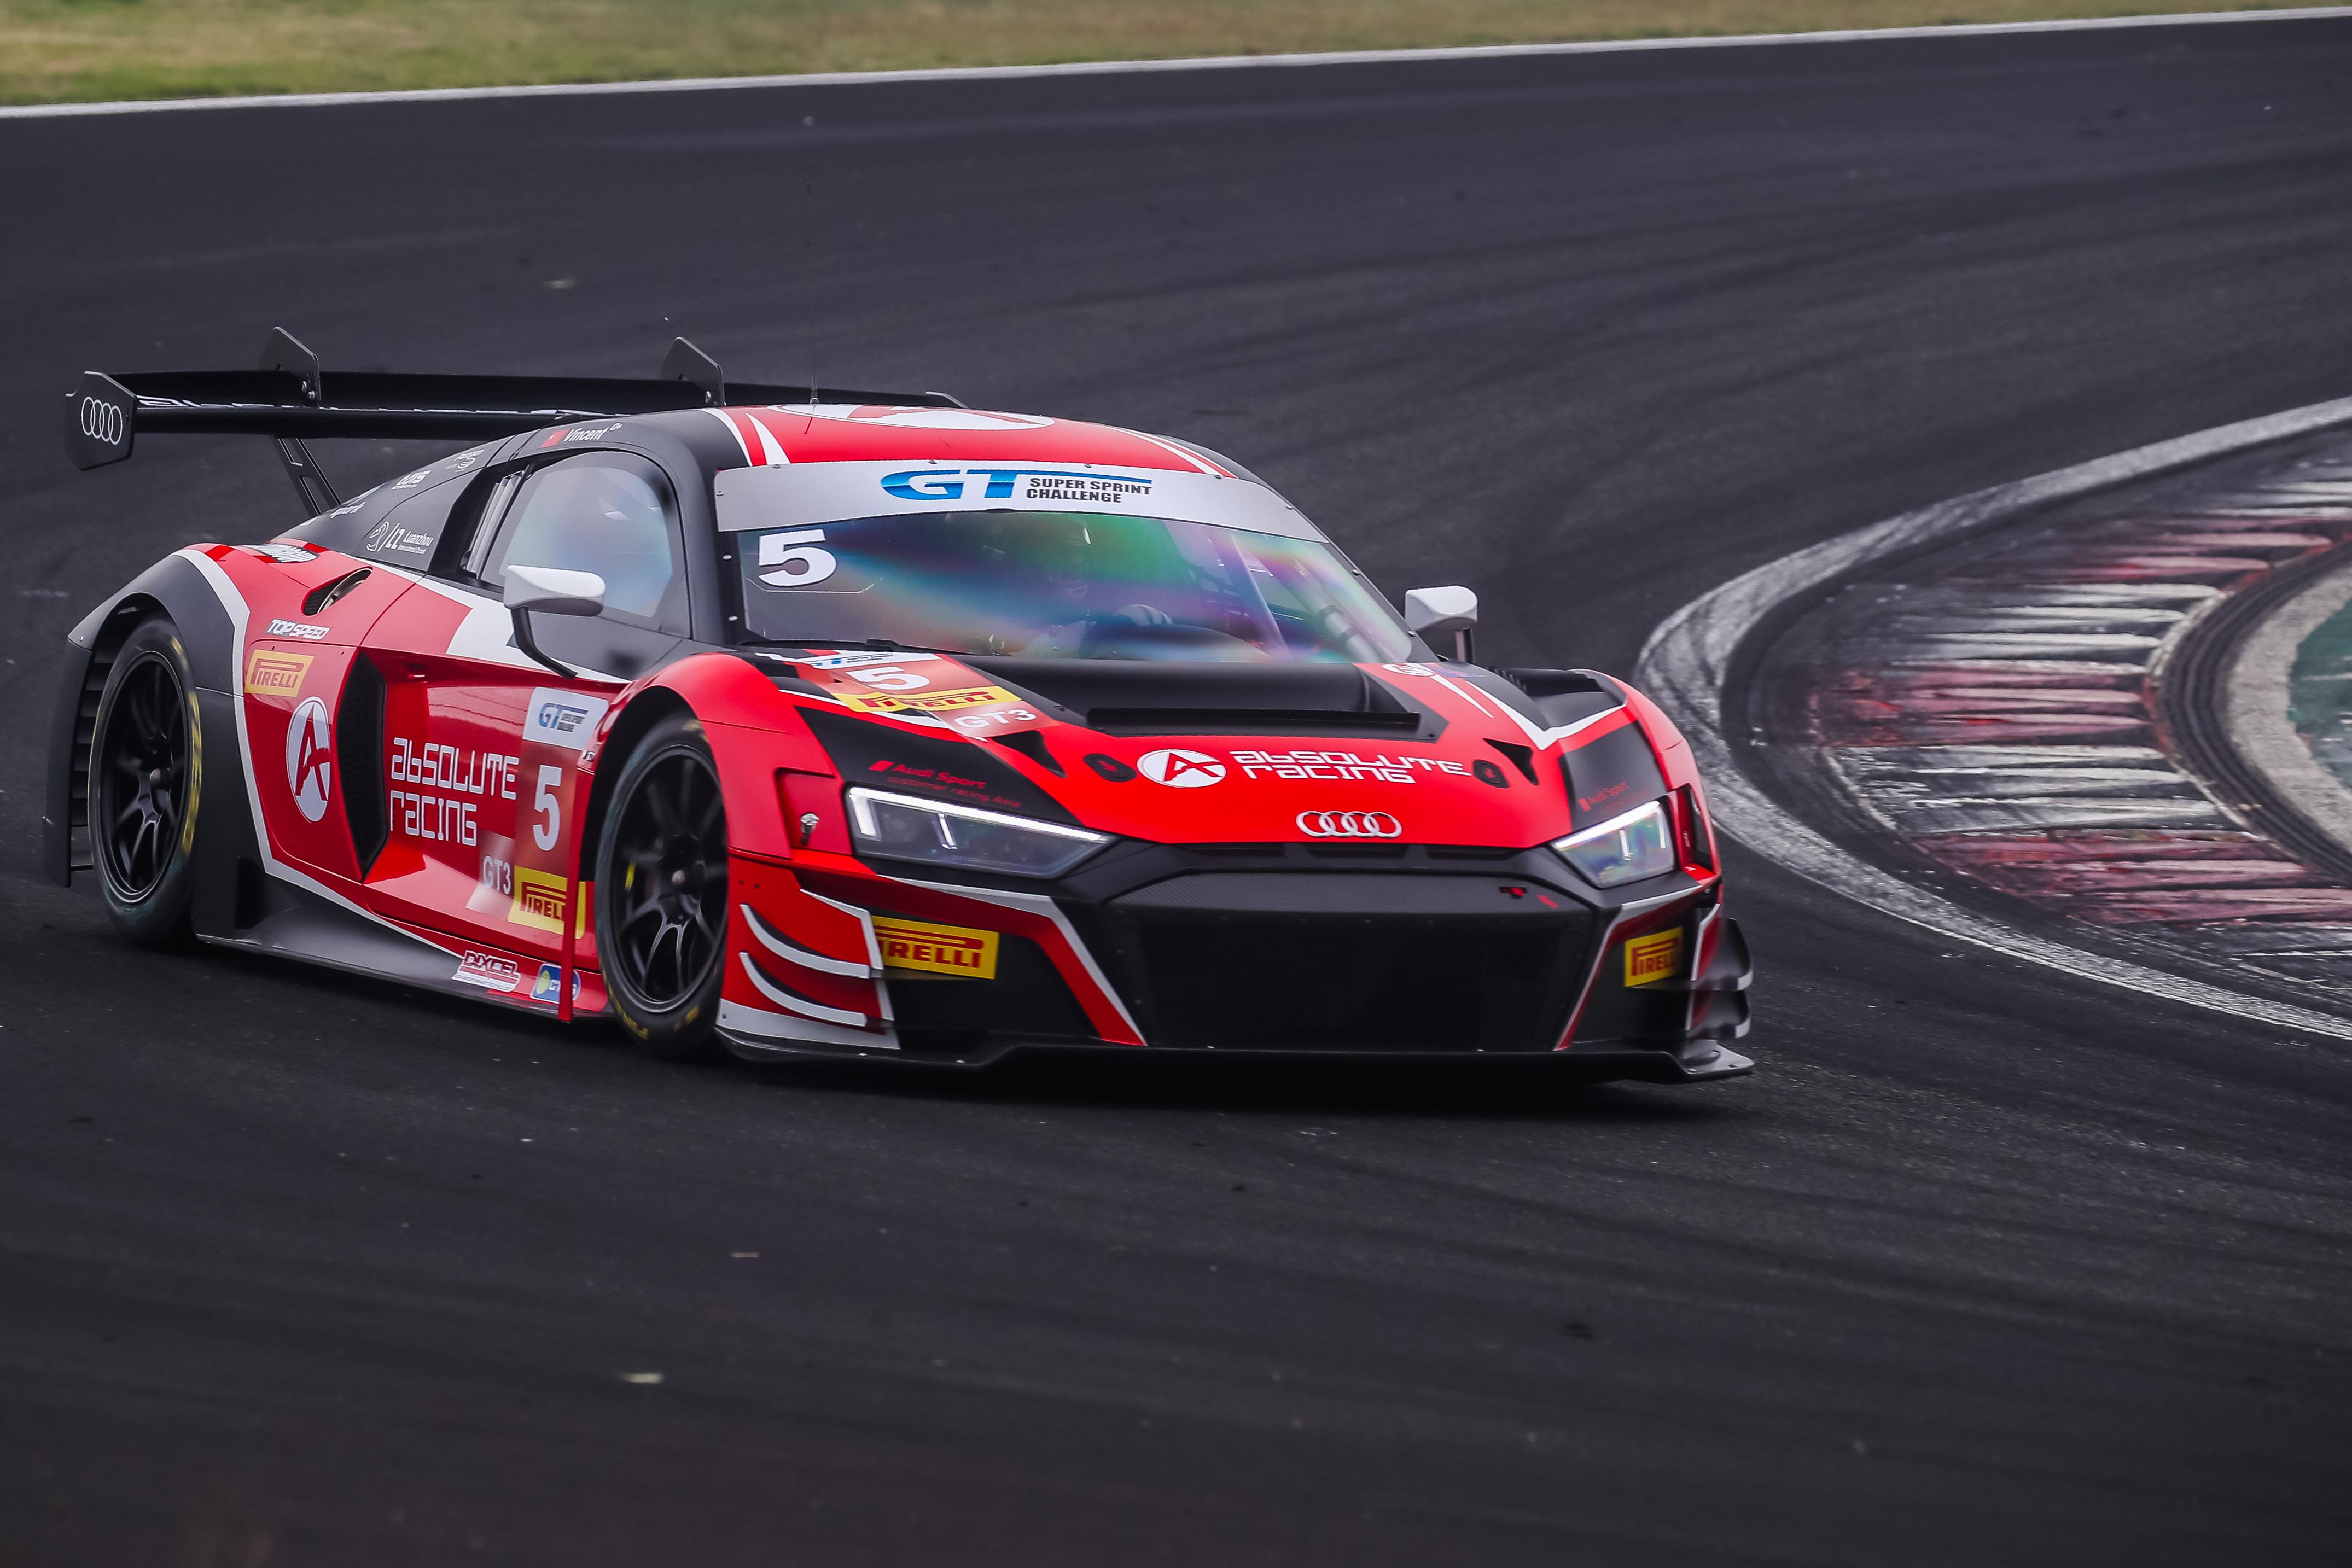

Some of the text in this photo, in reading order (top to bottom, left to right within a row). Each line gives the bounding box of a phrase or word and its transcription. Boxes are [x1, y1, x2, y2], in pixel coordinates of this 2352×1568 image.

[563, 427, 609, 442] Vincent
[1026, 488, 1122, 503] CHALLENGE
[1029, 477, 1153, 495] SUPER SPRINT
[758, 529, 837, 586] 5
[251, 658, 304, 688] PIRELLI
[845, 666, 930, 690] 5
[953, 709, 1037, 728] GT3
[892, 763, 986, 789] Audi Sport
[532, 764, 562, 851] 5
[483, 855, 511, 894] GT3
